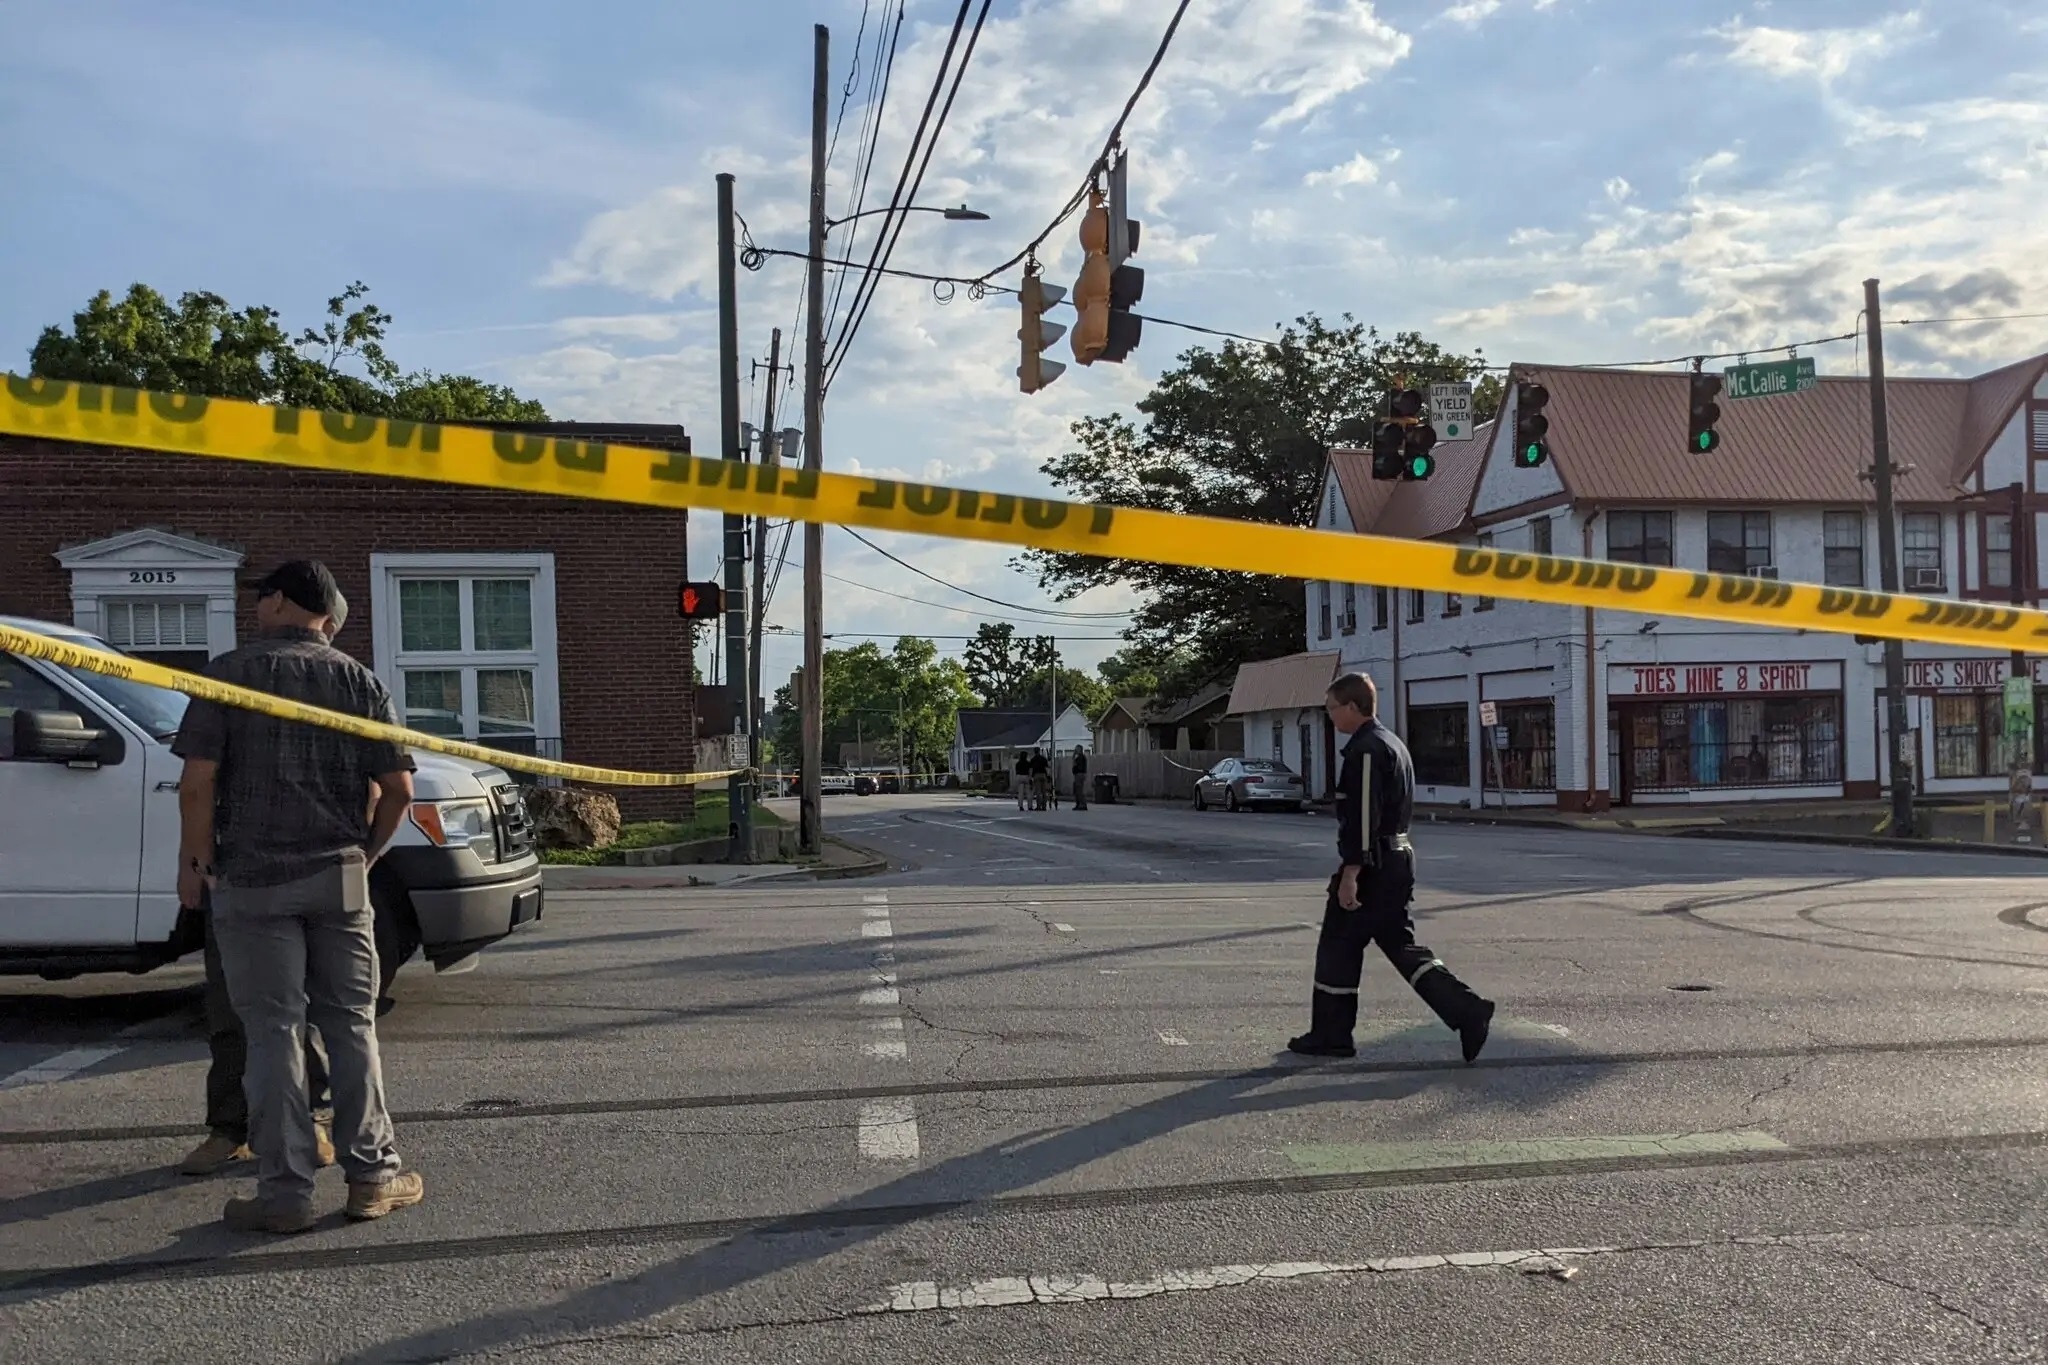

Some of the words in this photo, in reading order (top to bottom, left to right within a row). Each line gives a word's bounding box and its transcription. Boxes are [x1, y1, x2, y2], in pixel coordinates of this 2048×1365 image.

[1727, 371, 1747, 396] Mc
[1750, 368, 1787, 394] Callie
[1431, 386, 1448, 397] LEFT
[1452, 386, 1470, 396] TURN
[1435, 398, 1467, 410] YIELD
[1433, 412, 1443, 422] ON
[1446, 411, 1471, 422] GREEN
[129, 571, 176, 583] 2015
[1903, 660, 1945, 686] JOES
[1953, 660, 2004, 686] SMOKE
[1633, 666, 1676, 693] JOES
[1686, 666, 1724, 693] WINE
